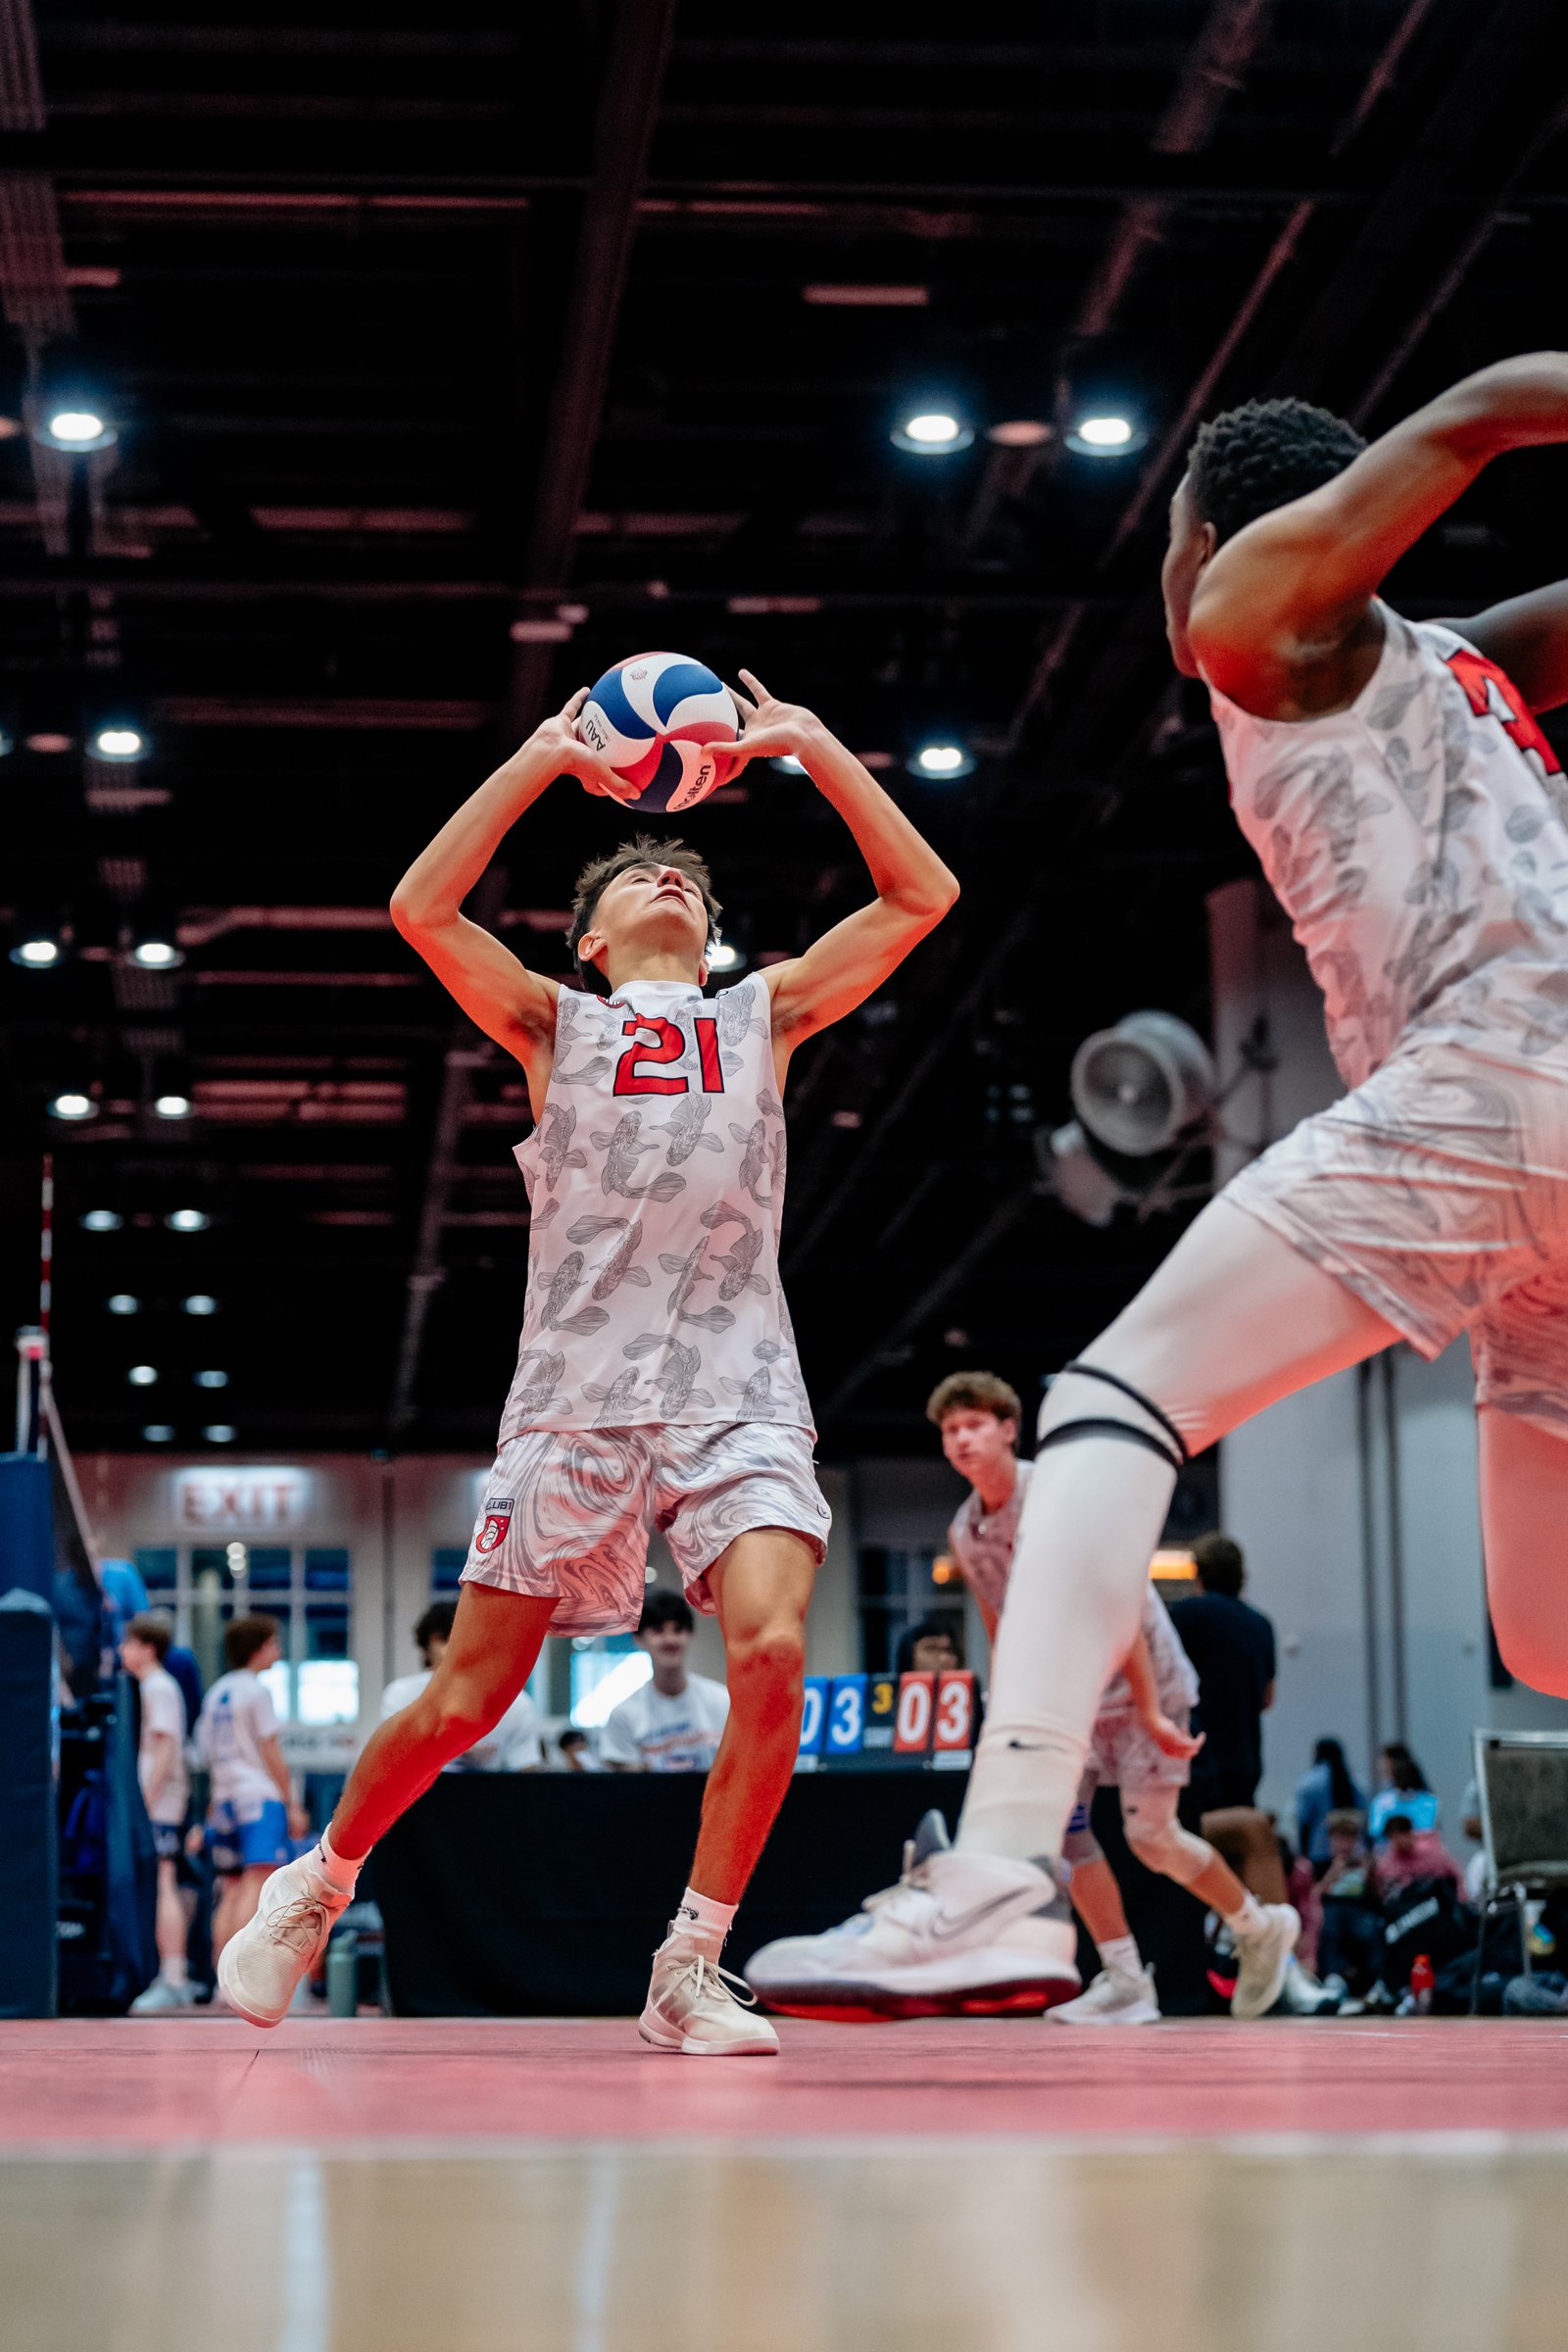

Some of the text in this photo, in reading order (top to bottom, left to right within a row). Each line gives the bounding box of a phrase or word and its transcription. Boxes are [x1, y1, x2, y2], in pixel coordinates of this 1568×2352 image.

[586, 719, 606, 752] AAU
[612, 1012, 725, 1097] 21
[182, 1483, 295, 1522] EXIT
[872, 1683, 894, 1714] 3
